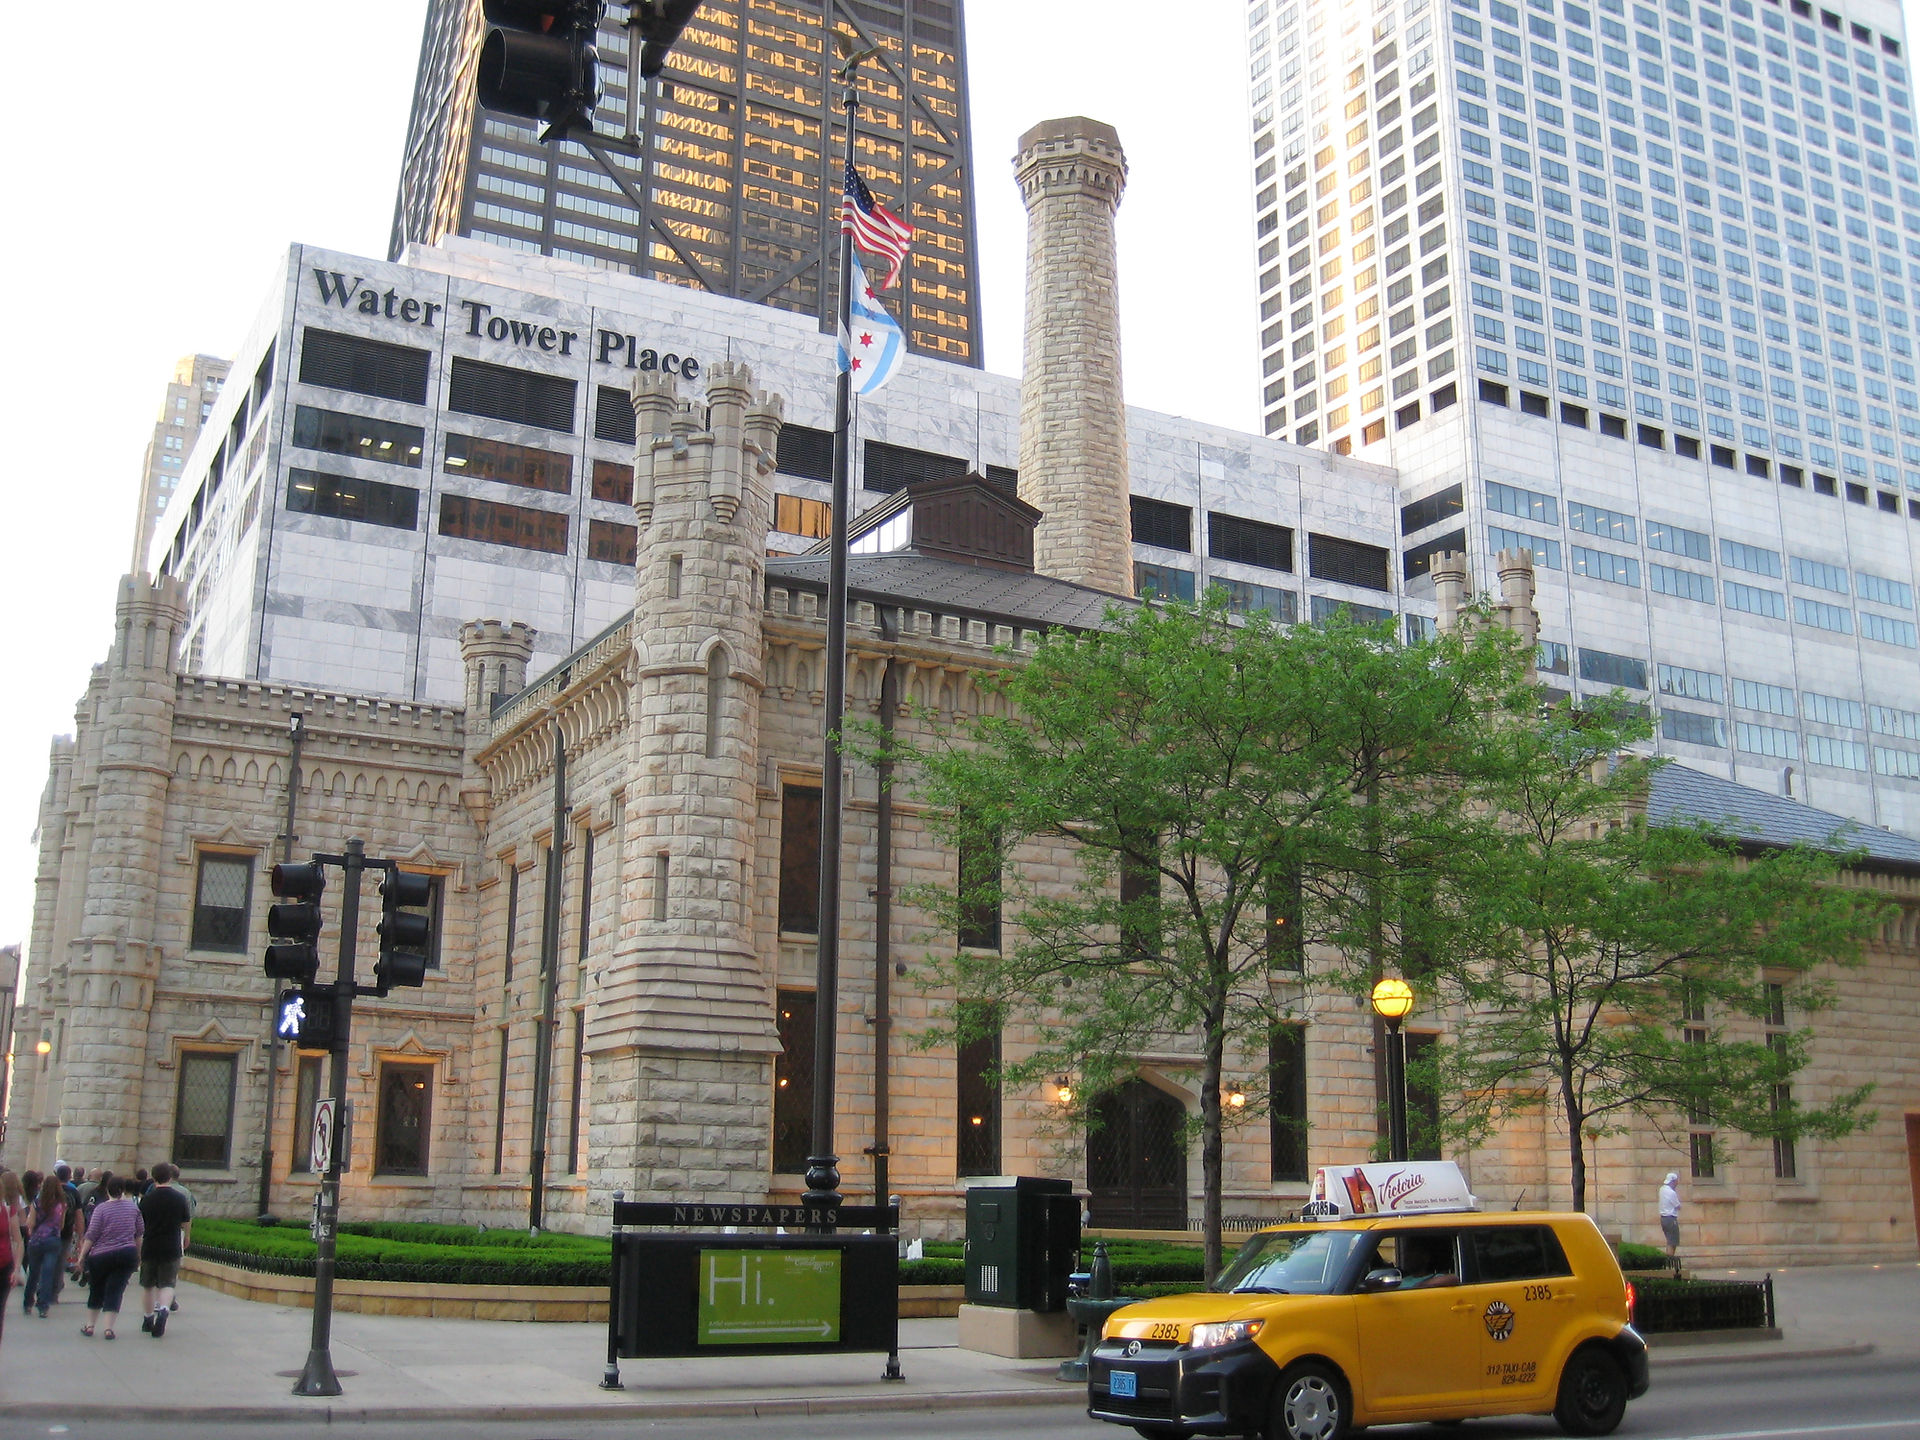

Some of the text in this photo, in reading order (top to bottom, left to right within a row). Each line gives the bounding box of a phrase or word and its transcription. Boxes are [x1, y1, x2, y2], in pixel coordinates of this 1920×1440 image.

[312, 268, 700, 381] Water Tower Place
[1377, 1168, 1425, 1210] Victoria
[674, 1206, 838, 1224] NEWSPAPERS
[1310, 1201, 1329, 1216] 2385
[709, 1255, 775, 1305] Hi.
[1523, 1284, 1552, 1301] 2385
[1152, 1323, 1180, 1339] 2385
